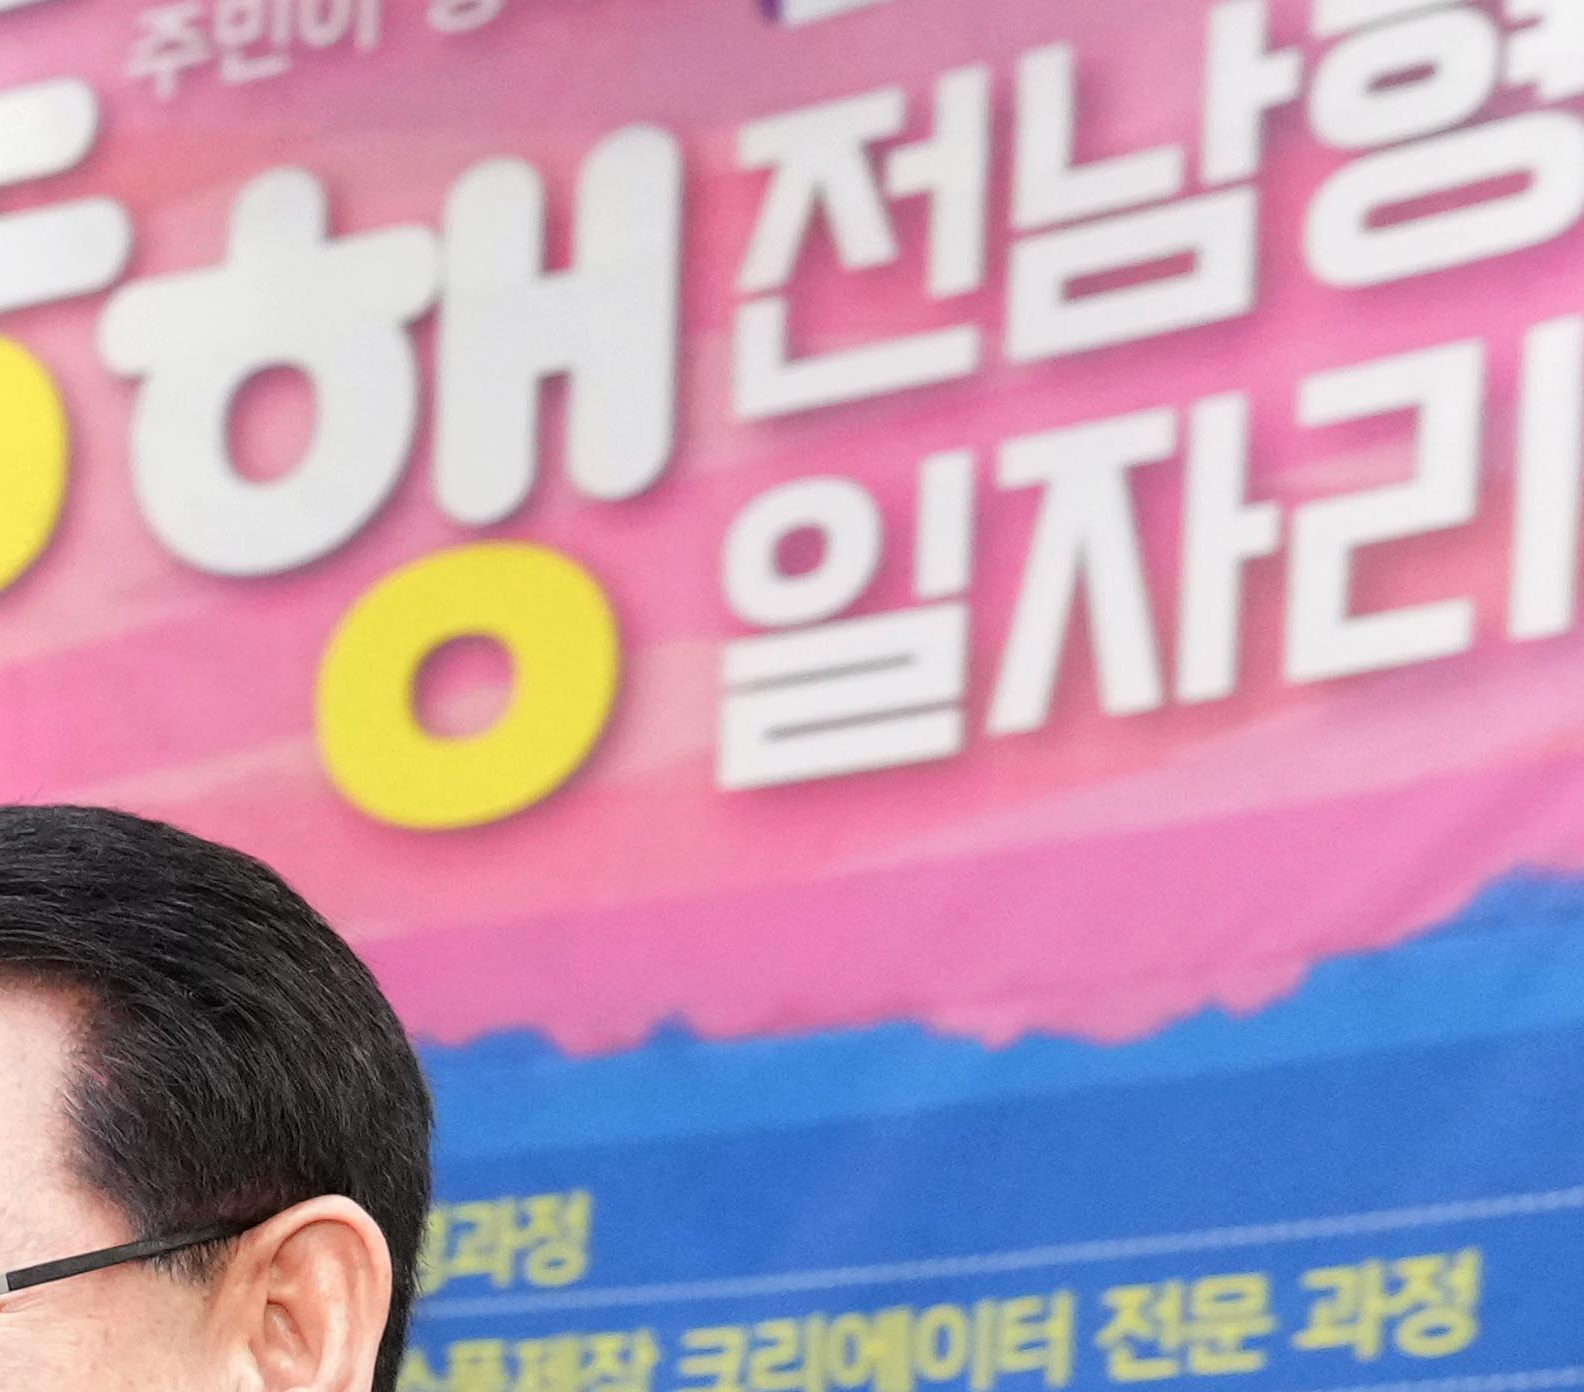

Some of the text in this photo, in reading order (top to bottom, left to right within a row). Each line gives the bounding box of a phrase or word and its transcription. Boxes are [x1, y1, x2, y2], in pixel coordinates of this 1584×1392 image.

[734, 0, 1584, 422] 전남형
[716, 314, 1584, 791] 일자리
[1095, 1270, 1277, 1384] 전문
[1292, 1246, 1483, 1361] 과정
